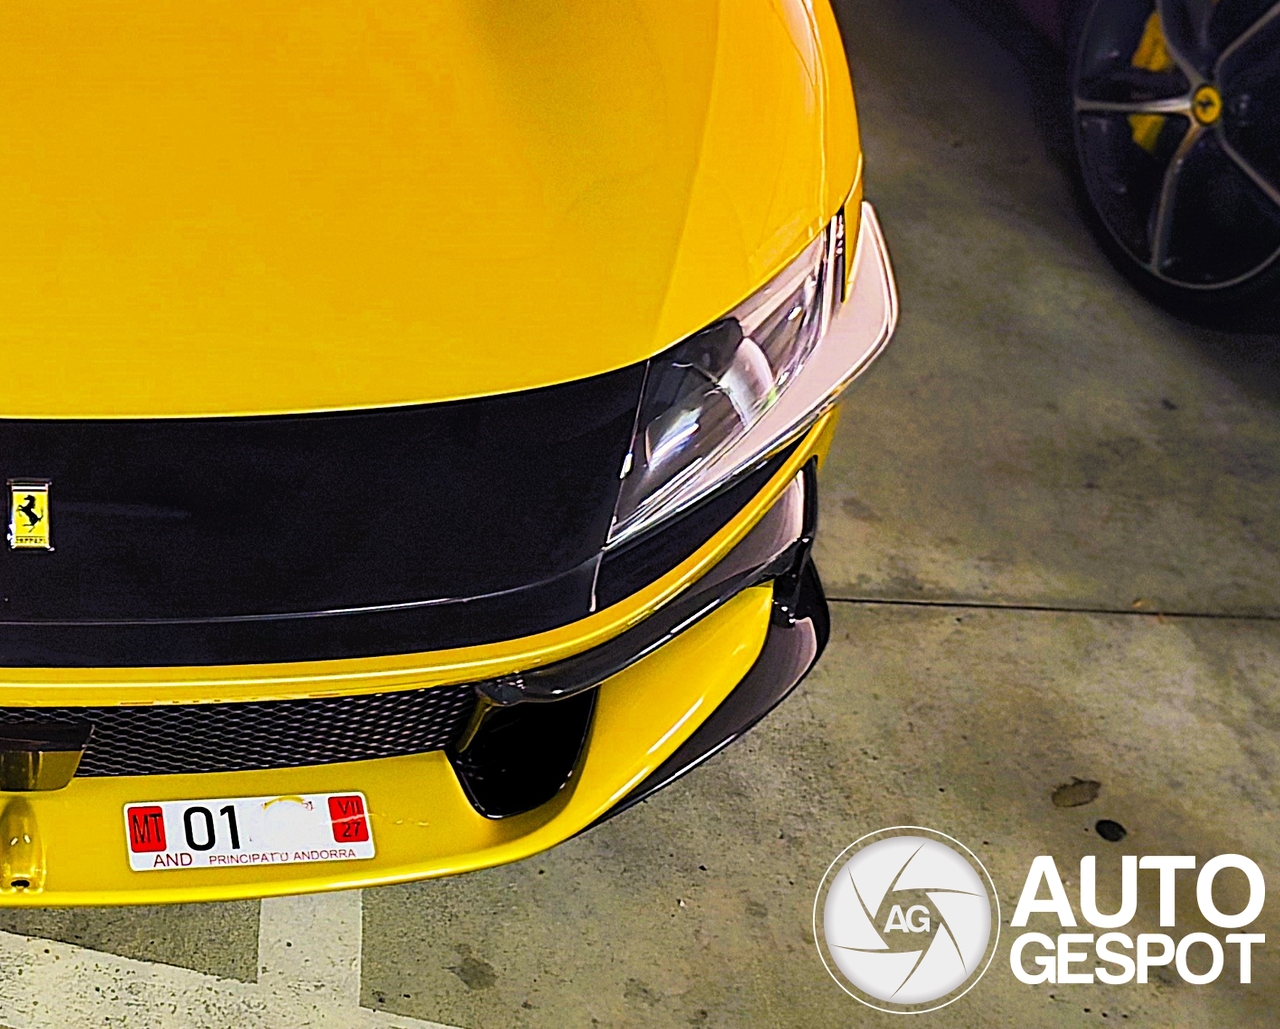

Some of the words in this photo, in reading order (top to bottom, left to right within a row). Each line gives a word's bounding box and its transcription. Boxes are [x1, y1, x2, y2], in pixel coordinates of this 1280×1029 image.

[133, 813, 162, 844] MT
[183, 805, 240, 851] 01
[342, 821, 361, 838] 27
[153, 853, 193, 867] AND
